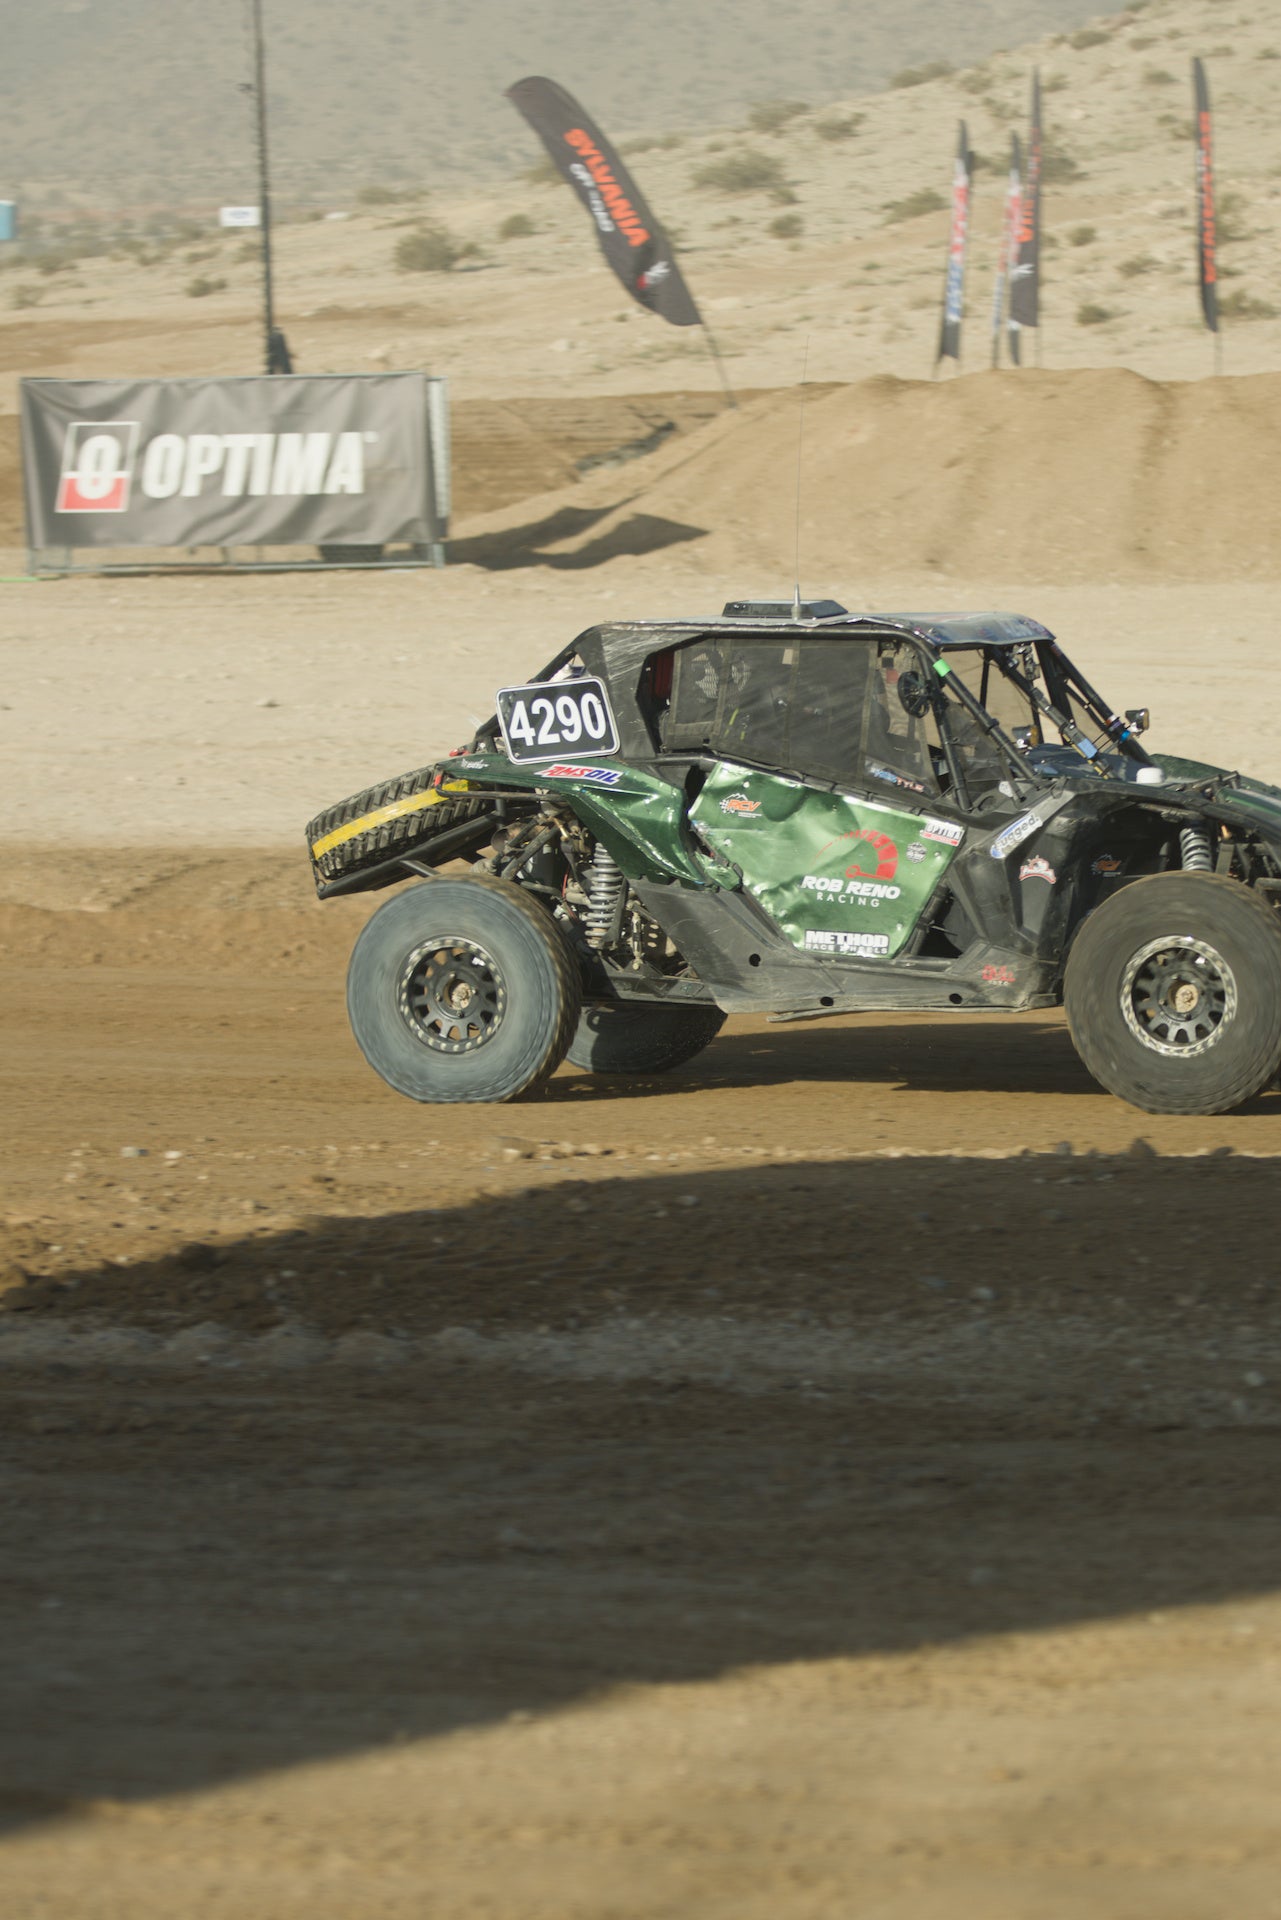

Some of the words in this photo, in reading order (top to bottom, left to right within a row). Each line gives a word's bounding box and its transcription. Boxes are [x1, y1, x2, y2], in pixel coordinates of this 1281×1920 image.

[562, 128, 651, 247] SYLVANIA
[141, 431, 365, 498] OPTIMA
[508, 692, 607, 747] 4290
[542, 765, 619, 784] AMSOIL
[801, 875, 844, 893] ROB
[845, 881, 901, 900] RENO
[816, 892, 880, 908] RACING
[805, 930, 889, 948] METHOD
[805, 943, 834, 952] RACE
[840, 944, 888, 955] HEELS
